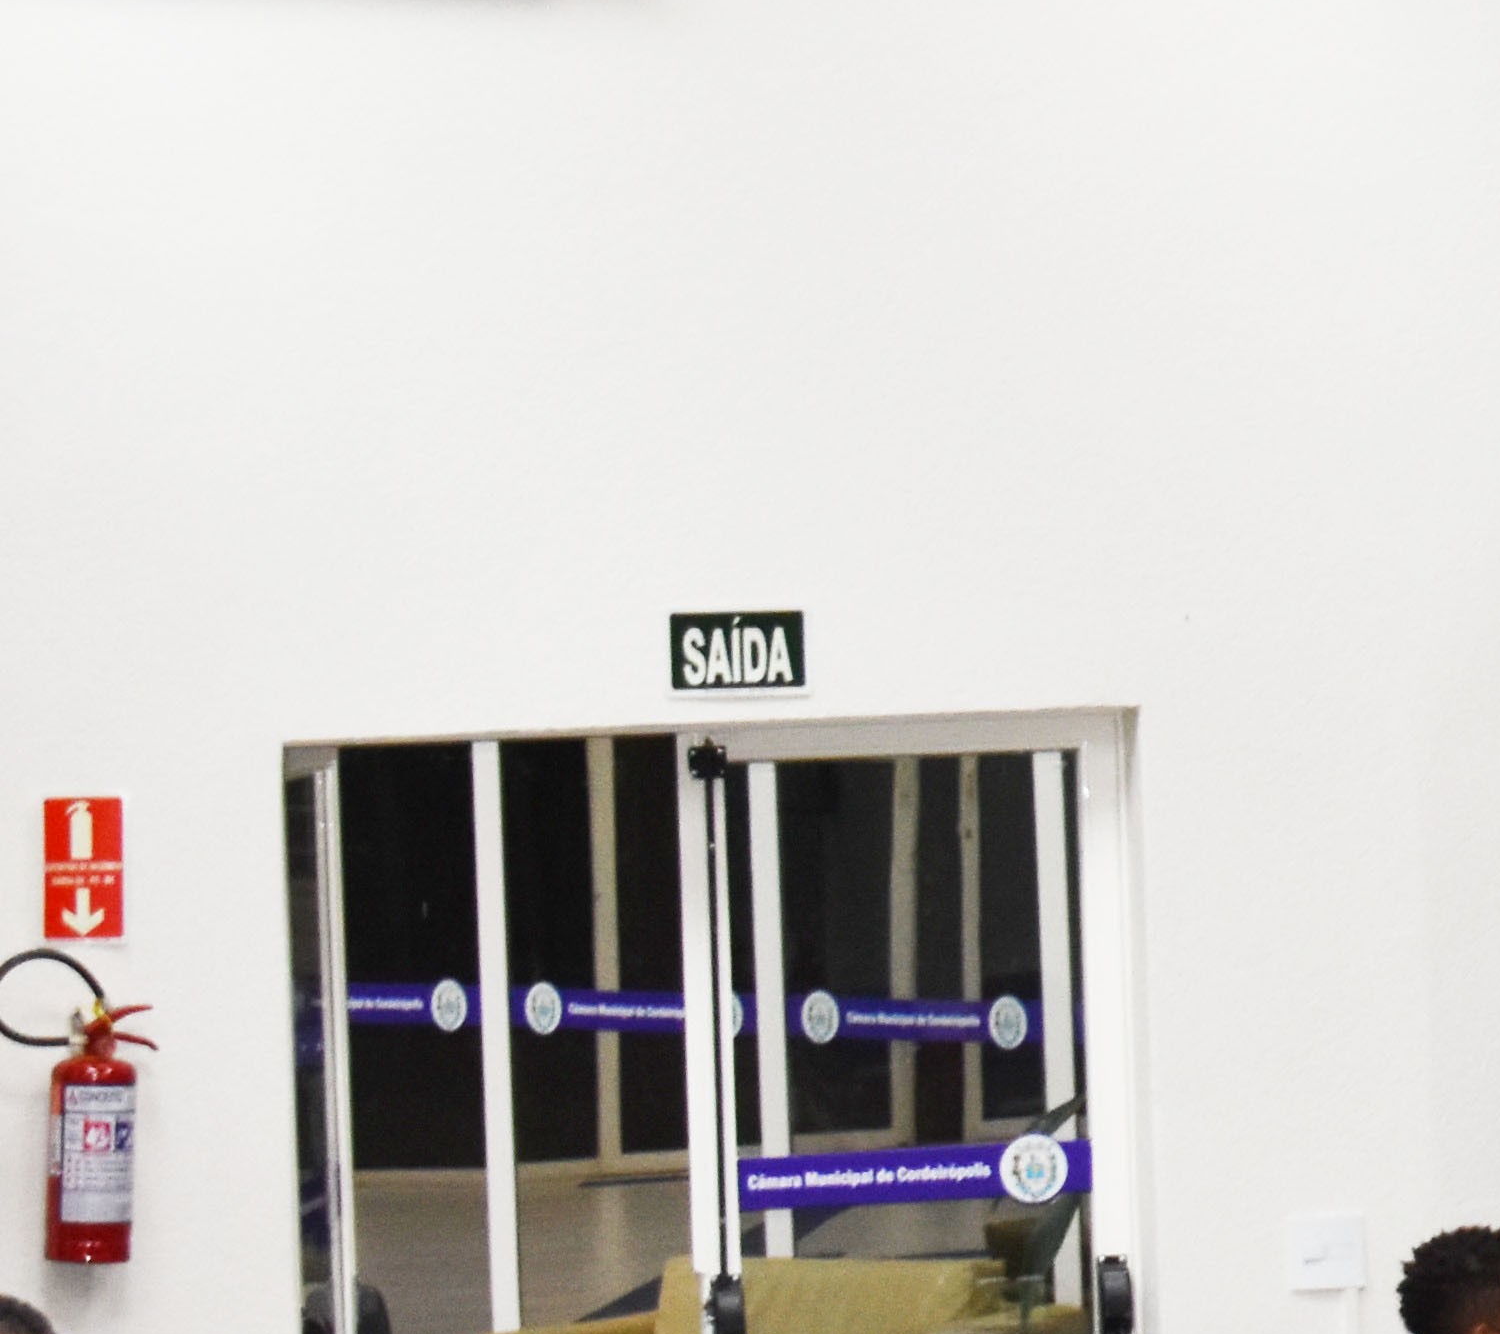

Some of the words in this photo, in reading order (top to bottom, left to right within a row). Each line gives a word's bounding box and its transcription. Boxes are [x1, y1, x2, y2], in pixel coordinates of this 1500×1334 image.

[682, 616, 793, 686] SAÍDA
[805, 1169, 874, 1188] Municipal
[876, 1168, 894, 1183] de
